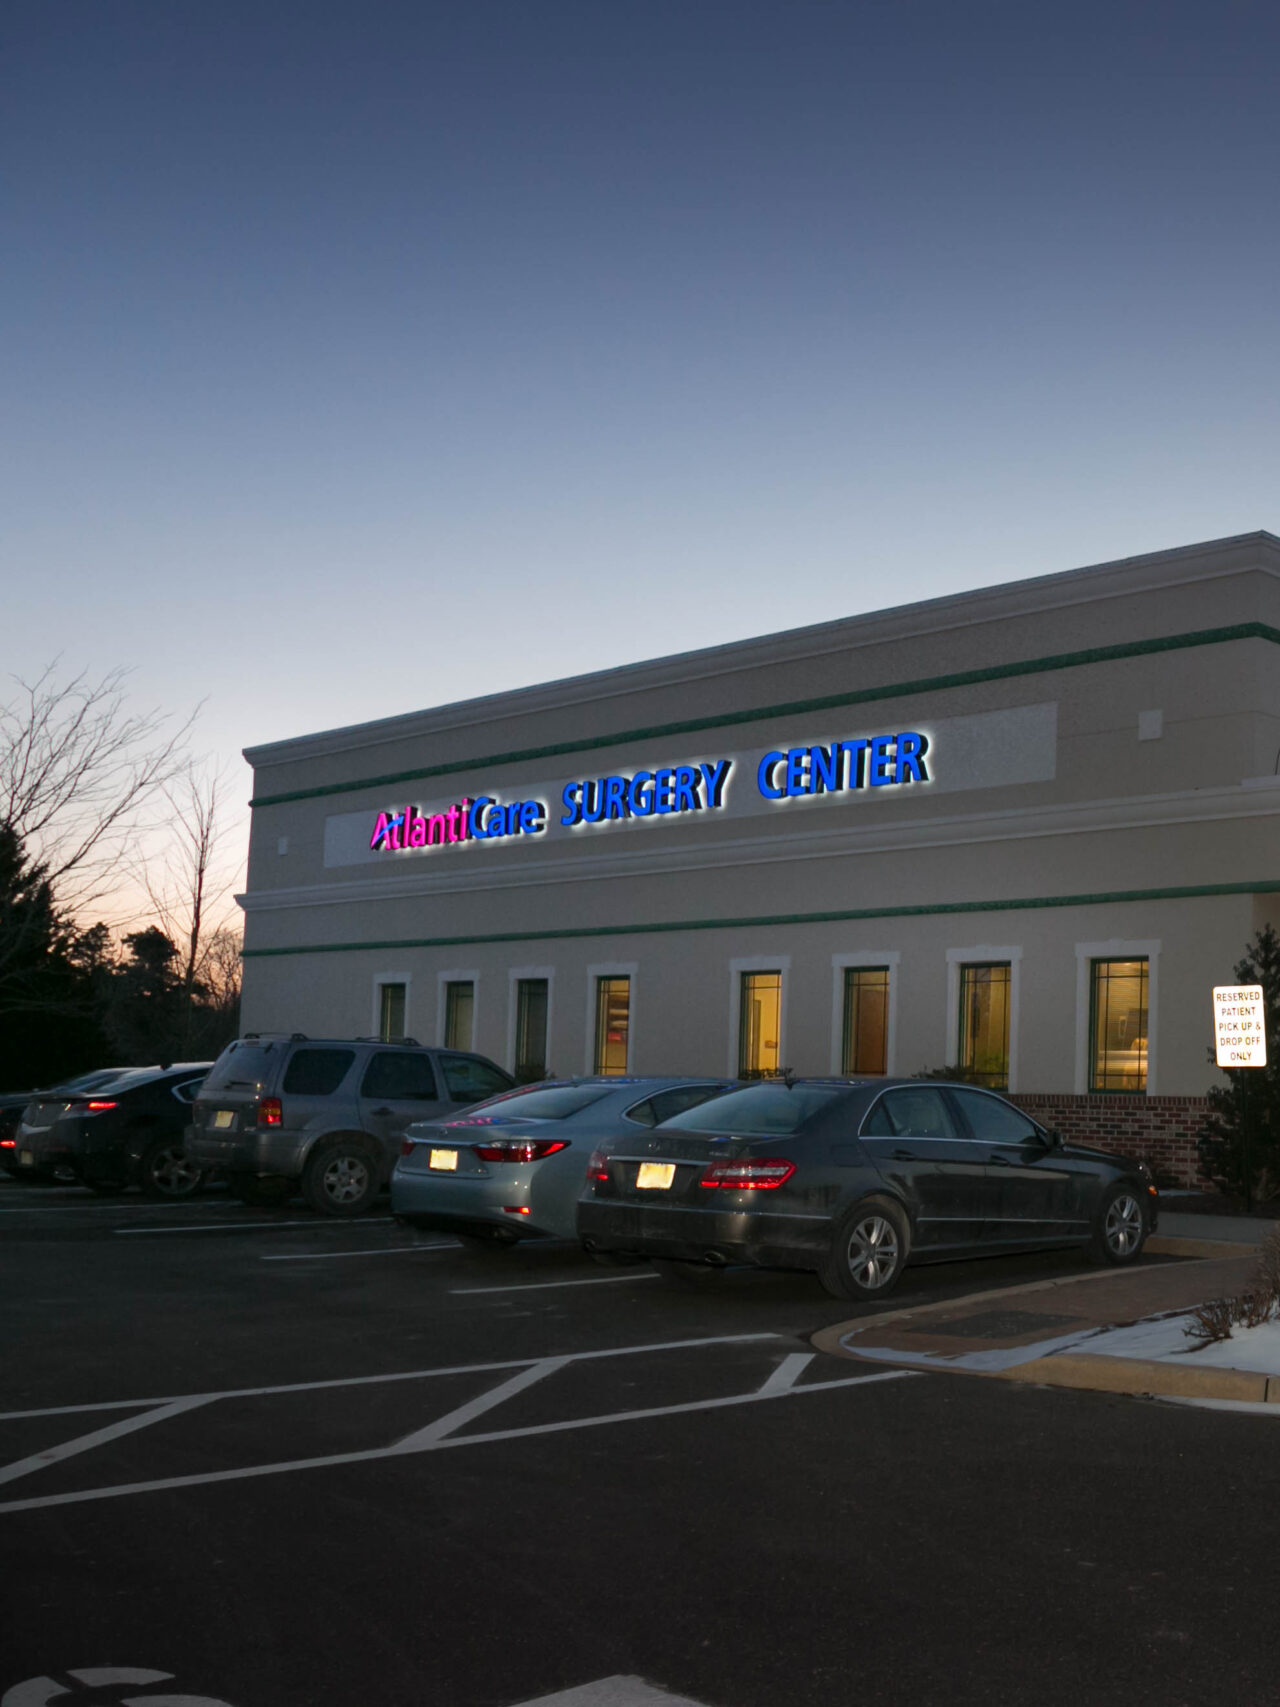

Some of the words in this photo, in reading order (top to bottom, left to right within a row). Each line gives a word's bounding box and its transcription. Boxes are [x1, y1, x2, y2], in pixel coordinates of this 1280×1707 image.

[370, 796, 547, 850] AtlantiCare
[561, 759, 732, 826] SURGERY
[757, 731, 932, 800] CENTER
[1216, 991, 1260, 1002] RESERVED
[1221, 1006, 1256, 1016] PATIENT
[1219, 1022, 1239, 1031] PICK
[1241, 1022, 1253, 1031] UP
[1255, 1022, 1261, 1031] &
[1220, 1037, 1243, 1046] DROP
[1245, 1036, 1260, 1045] OFF
[1230, 1052, 1252, 1061] ONLY
